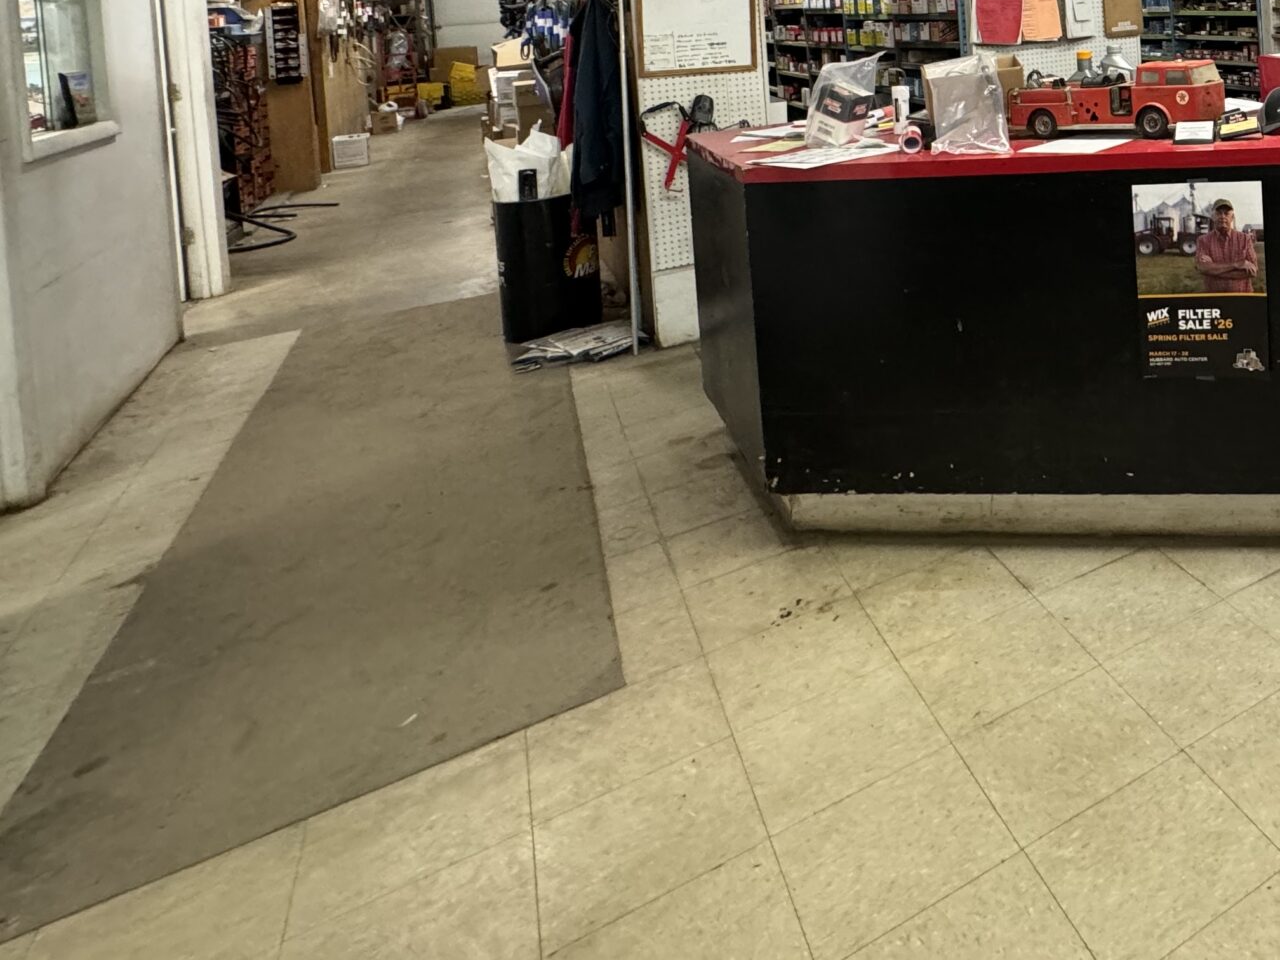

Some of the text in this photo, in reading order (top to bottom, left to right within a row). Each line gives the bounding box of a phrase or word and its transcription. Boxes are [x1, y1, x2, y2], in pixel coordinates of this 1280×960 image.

[1147, 307, 1221, 321] WIX FILTER
[1178, 319, 1212, 330] SALE
[1148, 334, 1178, 342] SPRING
